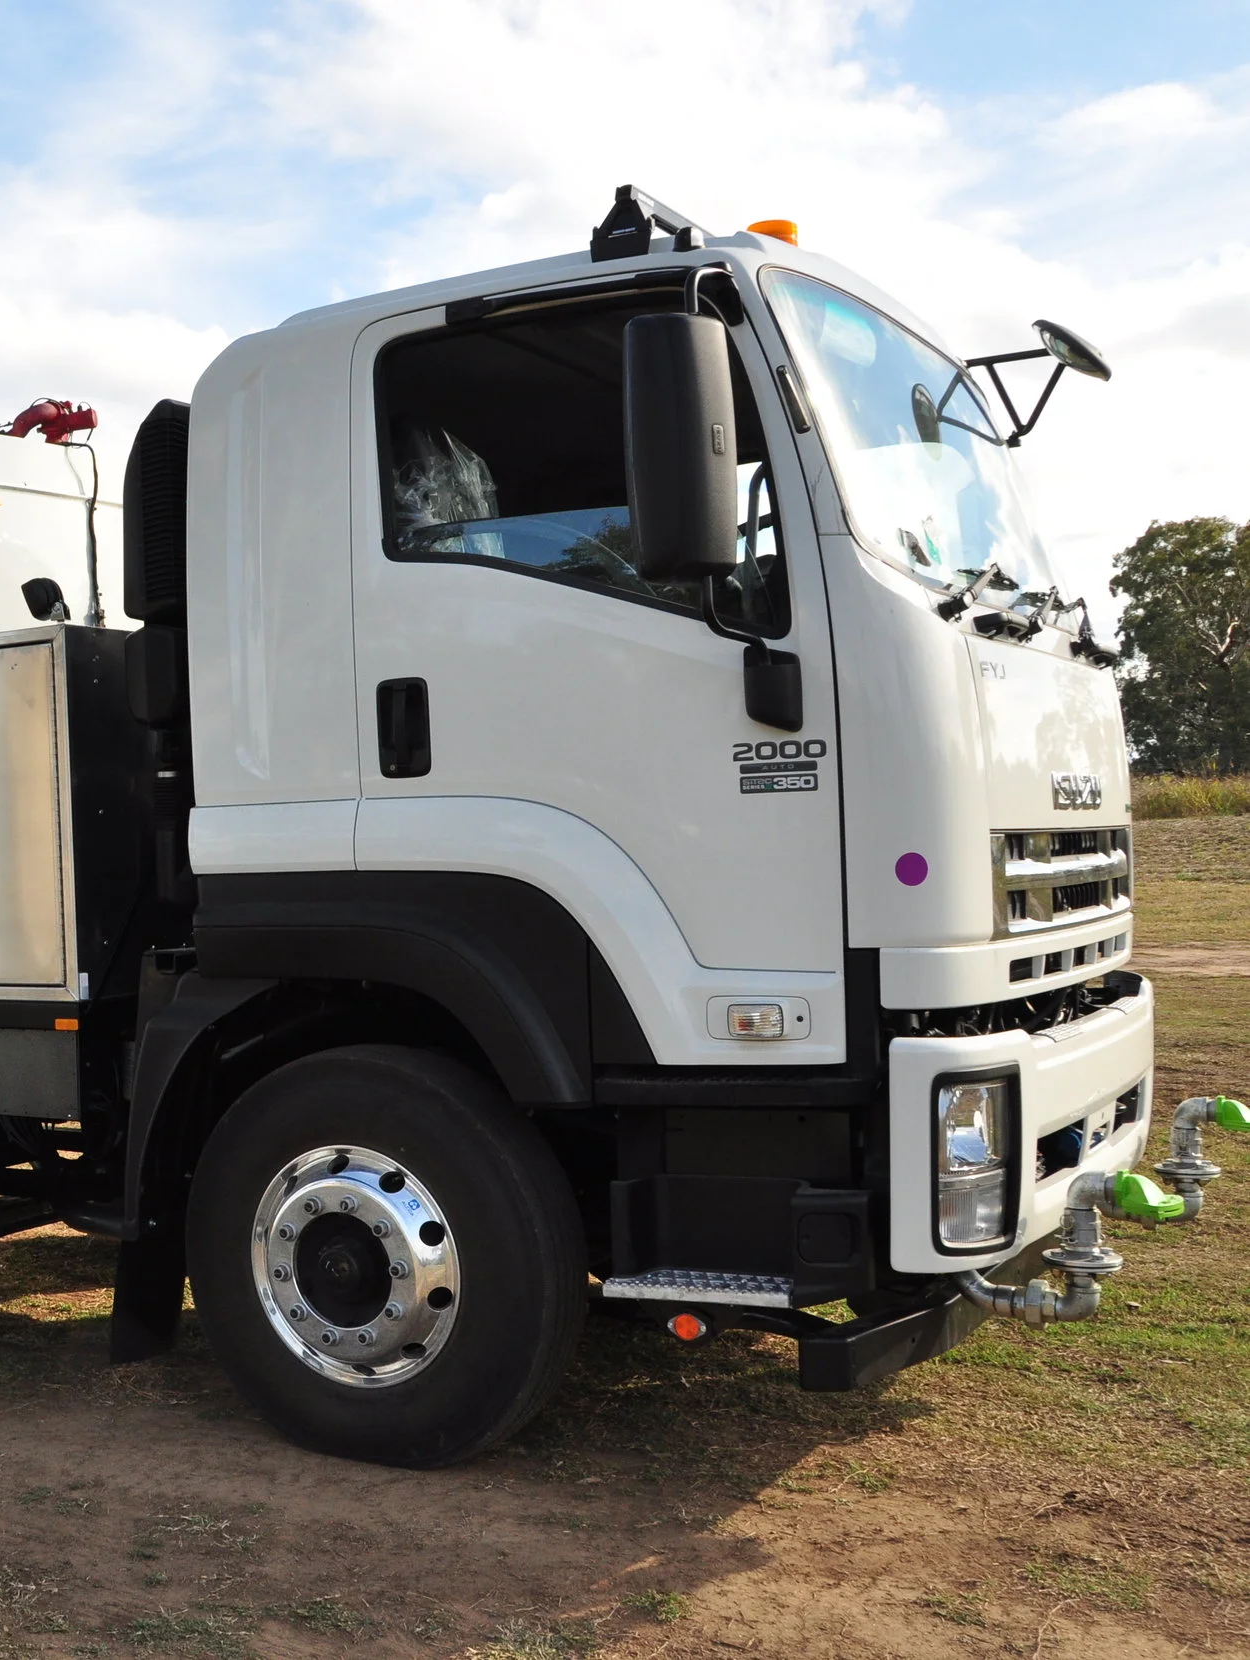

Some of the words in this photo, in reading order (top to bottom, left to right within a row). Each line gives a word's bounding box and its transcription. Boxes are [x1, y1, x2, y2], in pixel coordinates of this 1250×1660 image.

[980, 661, 1006, 679] FYJ
[732, 739, 827, 762] 2000
[773, 776, 815, 790] 350
